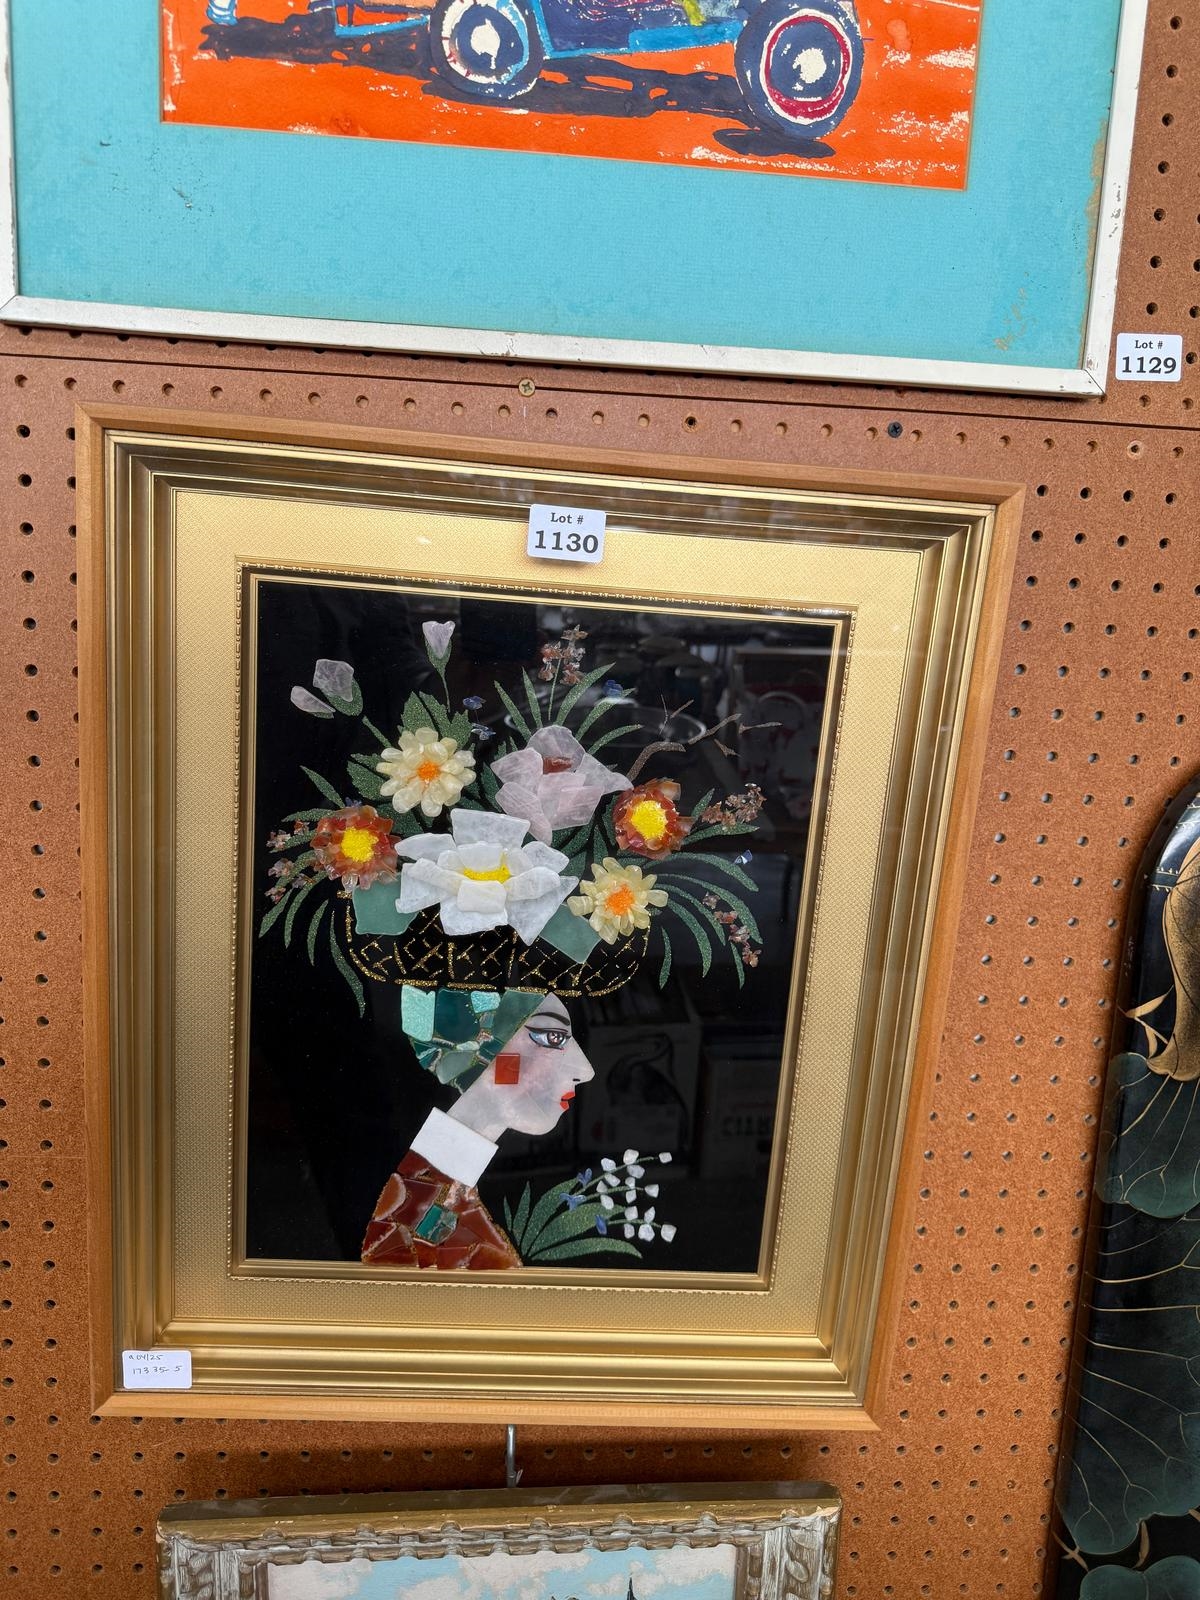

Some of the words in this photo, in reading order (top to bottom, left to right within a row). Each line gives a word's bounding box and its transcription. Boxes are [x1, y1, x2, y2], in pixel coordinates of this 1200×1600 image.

[1135, 340, 1153, 349] Lot
[1157, 340, 1163, 349] #
[1122, 356, 1176, 374] 1129
[551, 512, 572, 524] Lot
[577, 515, 583, 524] #
[535, 530, 598, 553] 1130
